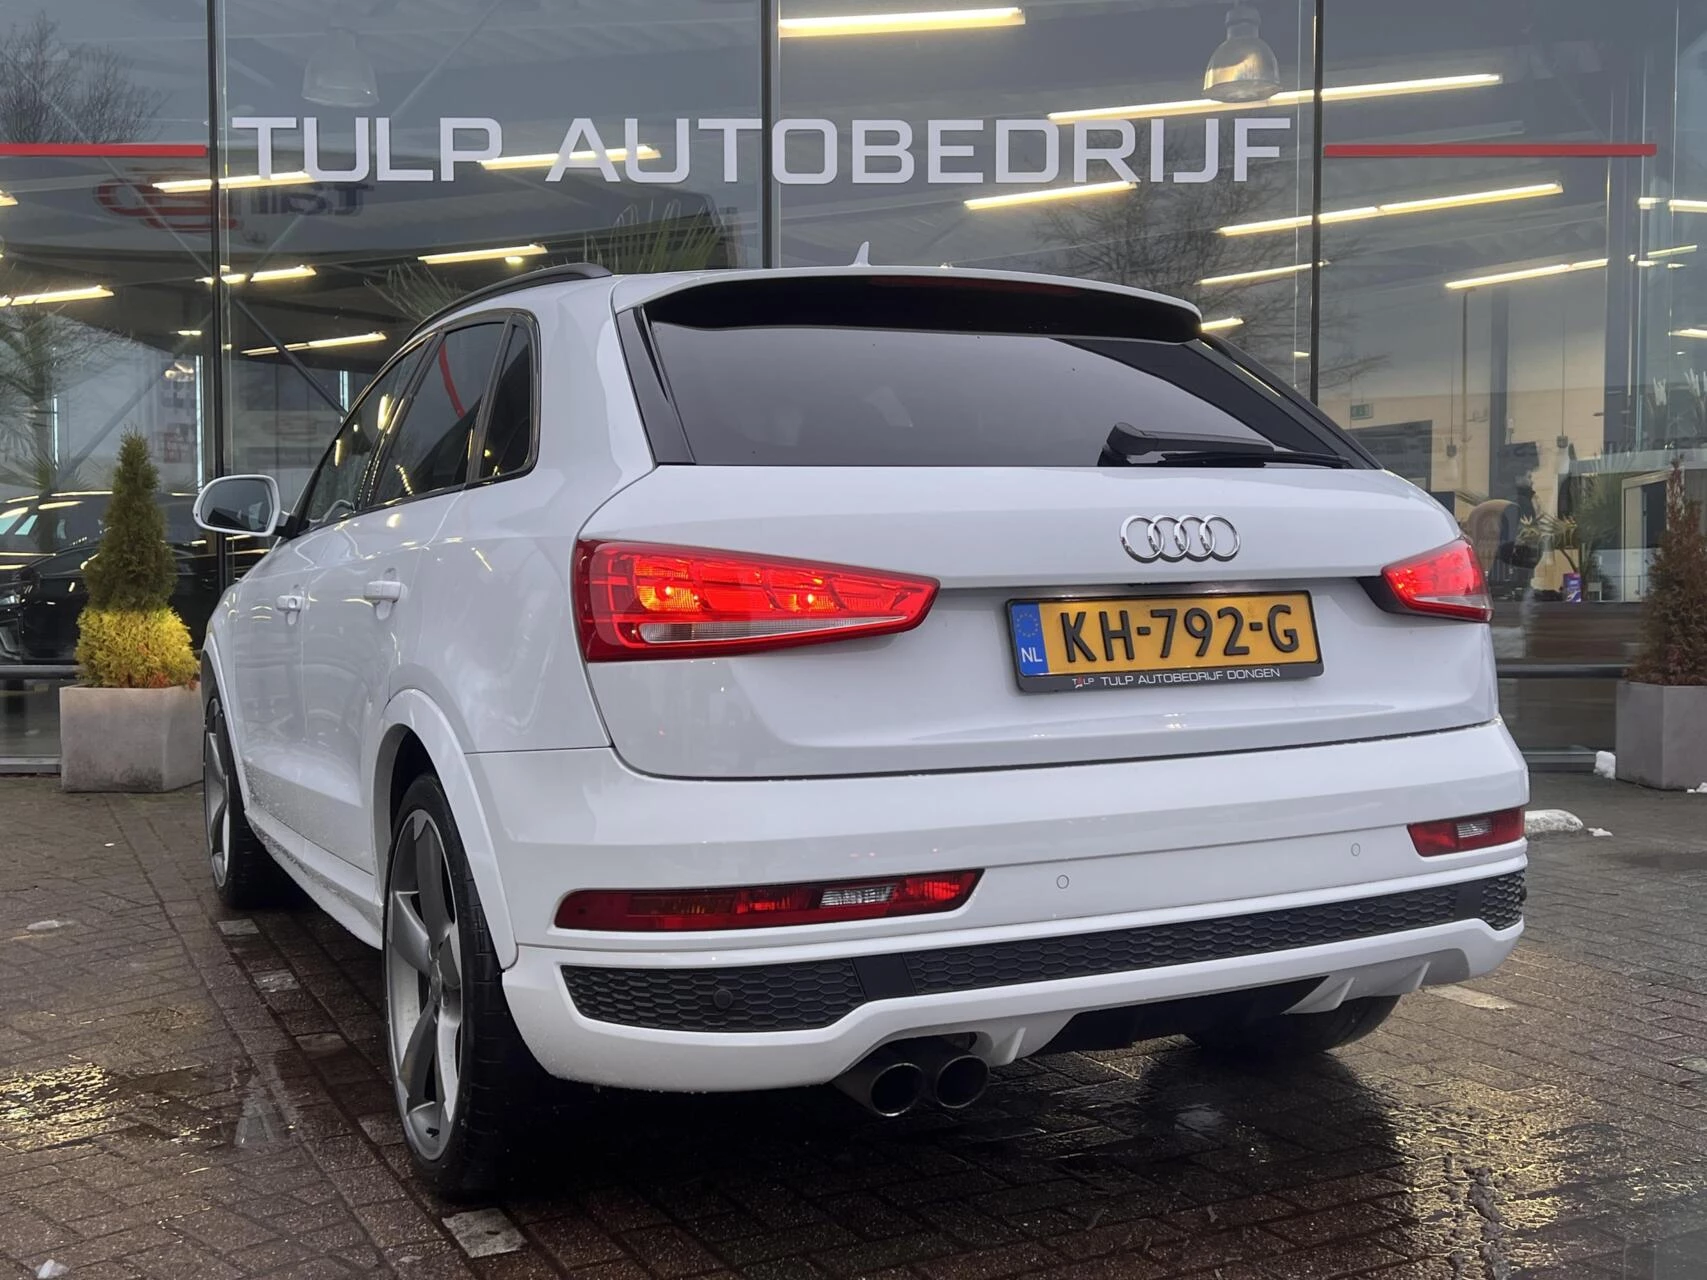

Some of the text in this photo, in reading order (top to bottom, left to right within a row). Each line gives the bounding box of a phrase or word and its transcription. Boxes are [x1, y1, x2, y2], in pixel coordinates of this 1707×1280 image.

[231, 116, 1291, 185] TULP AUTOBEDRIJF
[1060, 604, 1300, 663] KH-792-G
[1021, 647, 1043, 663] NL
[1100, 674, 1135, 687] TULP
[1138, 670, 1224, 685] AUTOBEDRIJF
[1227, 667, 1281, 681] DONGEN
